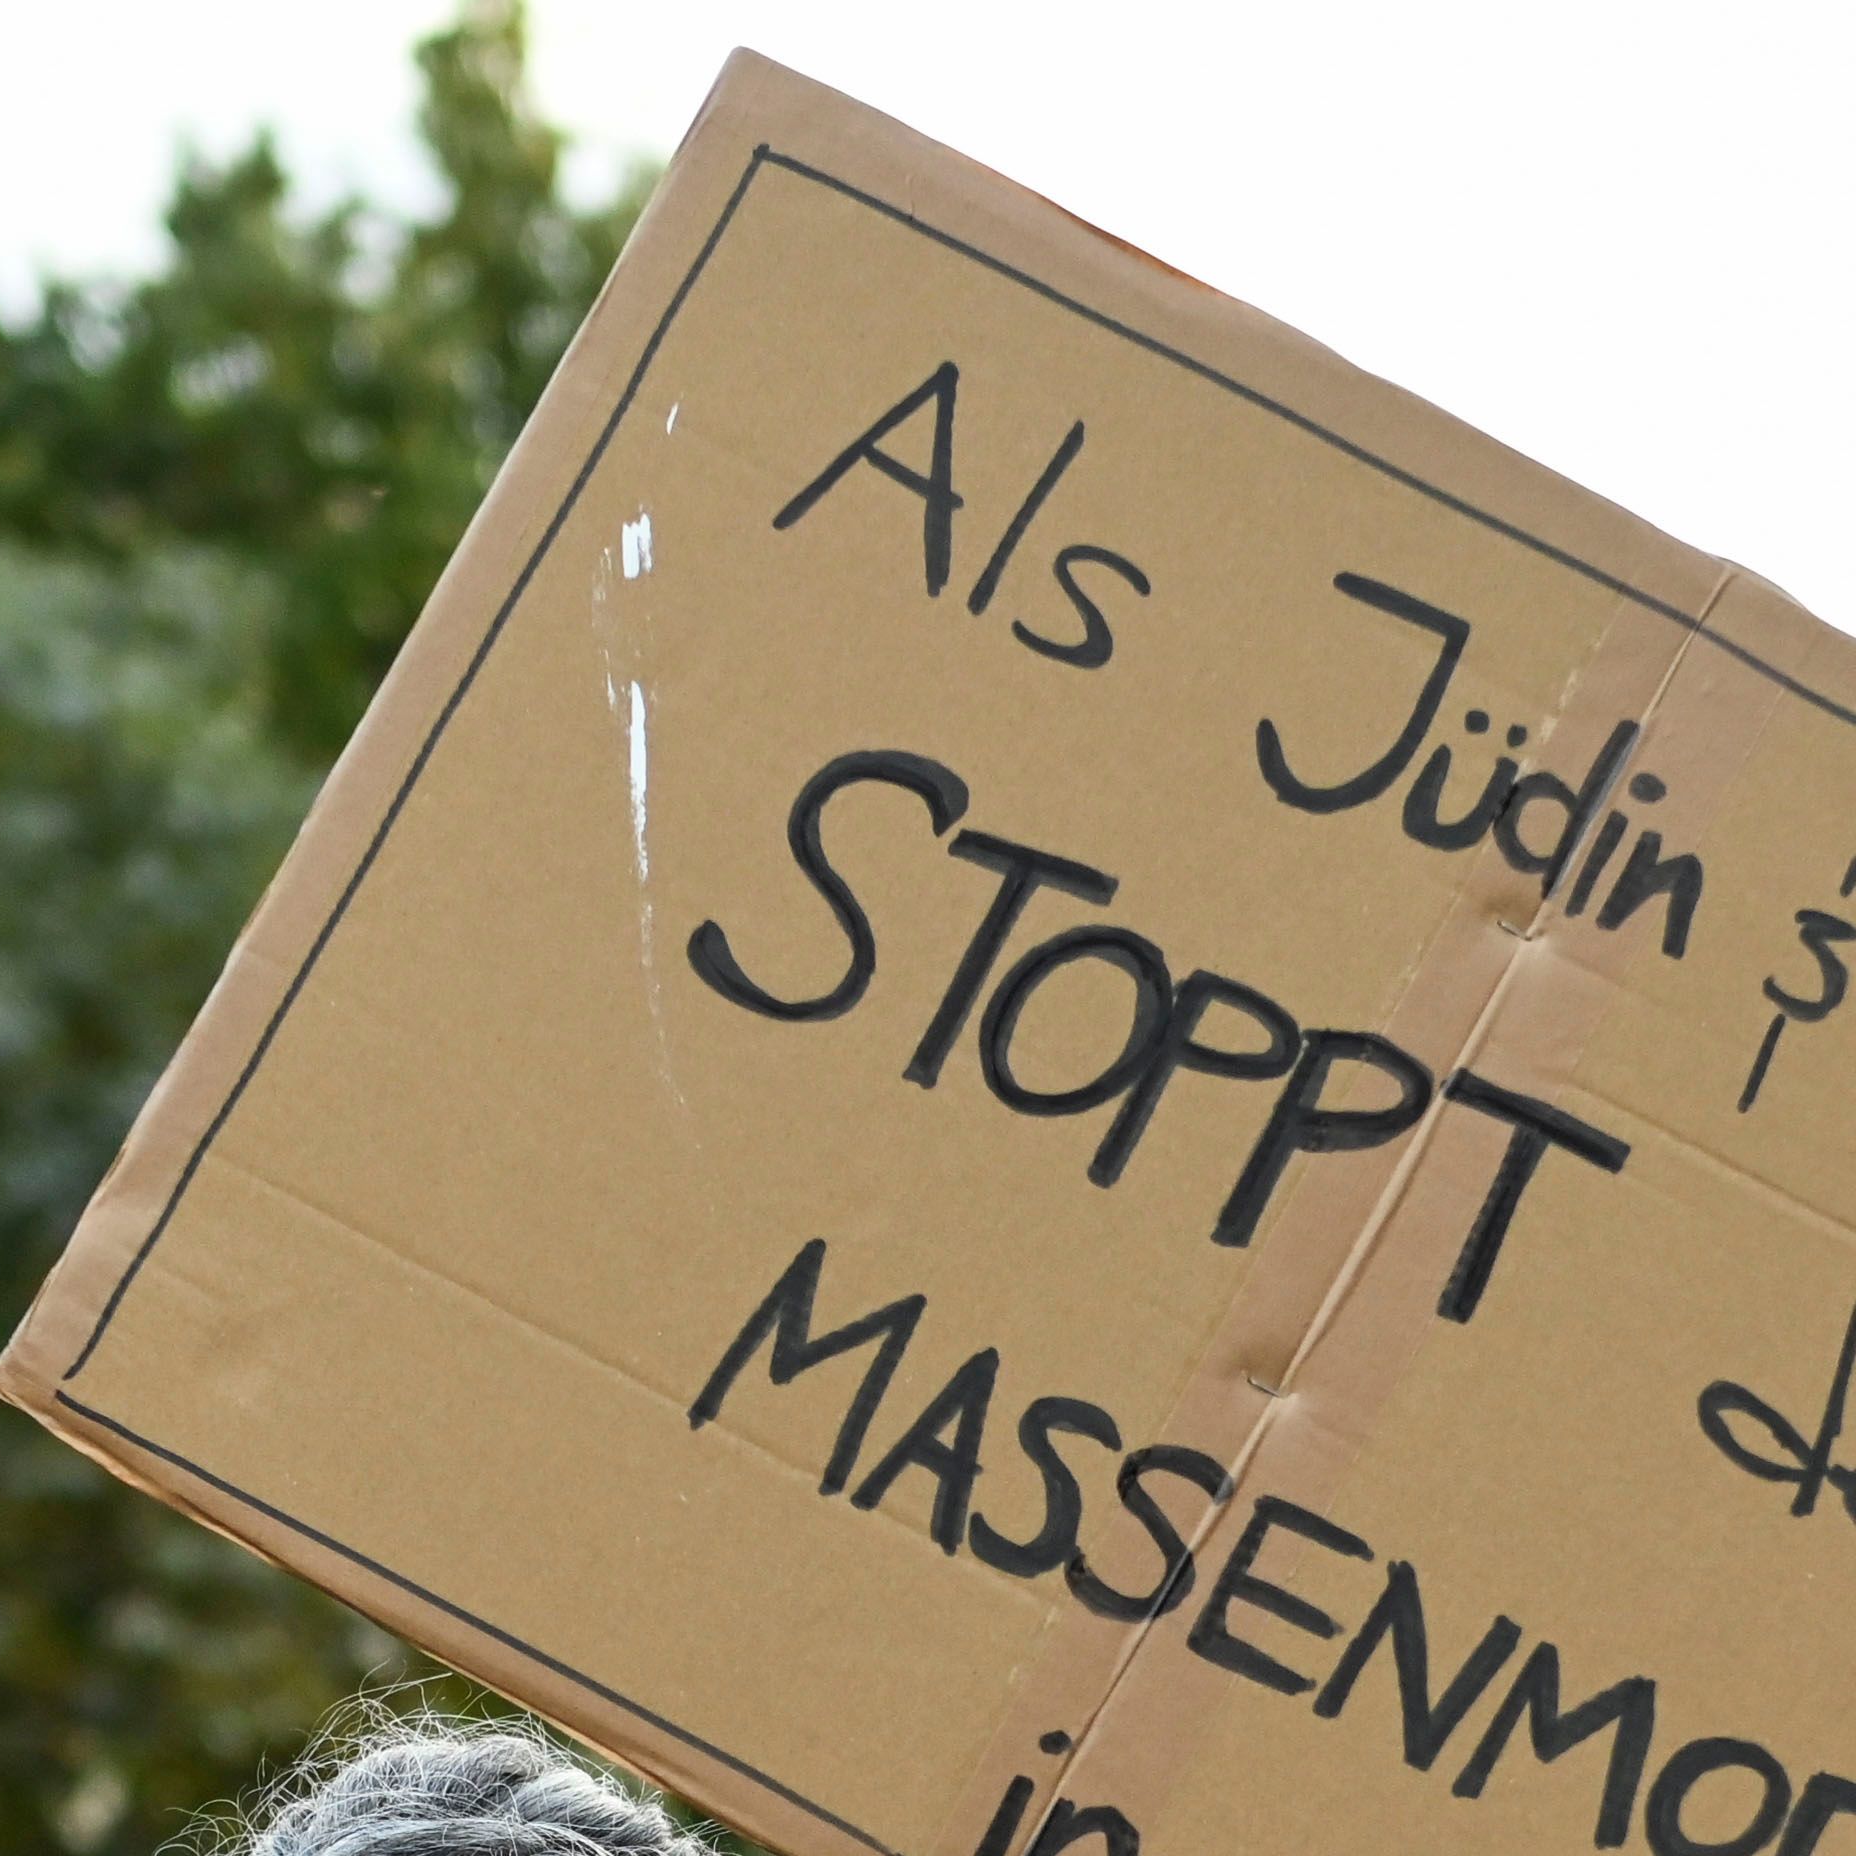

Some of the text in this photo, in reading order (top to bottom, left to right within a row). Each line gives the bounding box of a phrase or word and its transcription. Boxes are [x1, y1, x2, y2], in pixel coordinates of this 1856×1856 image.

[773, 362, 1150, 668] Als
[1257, 572, 1702, 959] Jüdin
[687, 751, 1630, 1323] STOPPT
